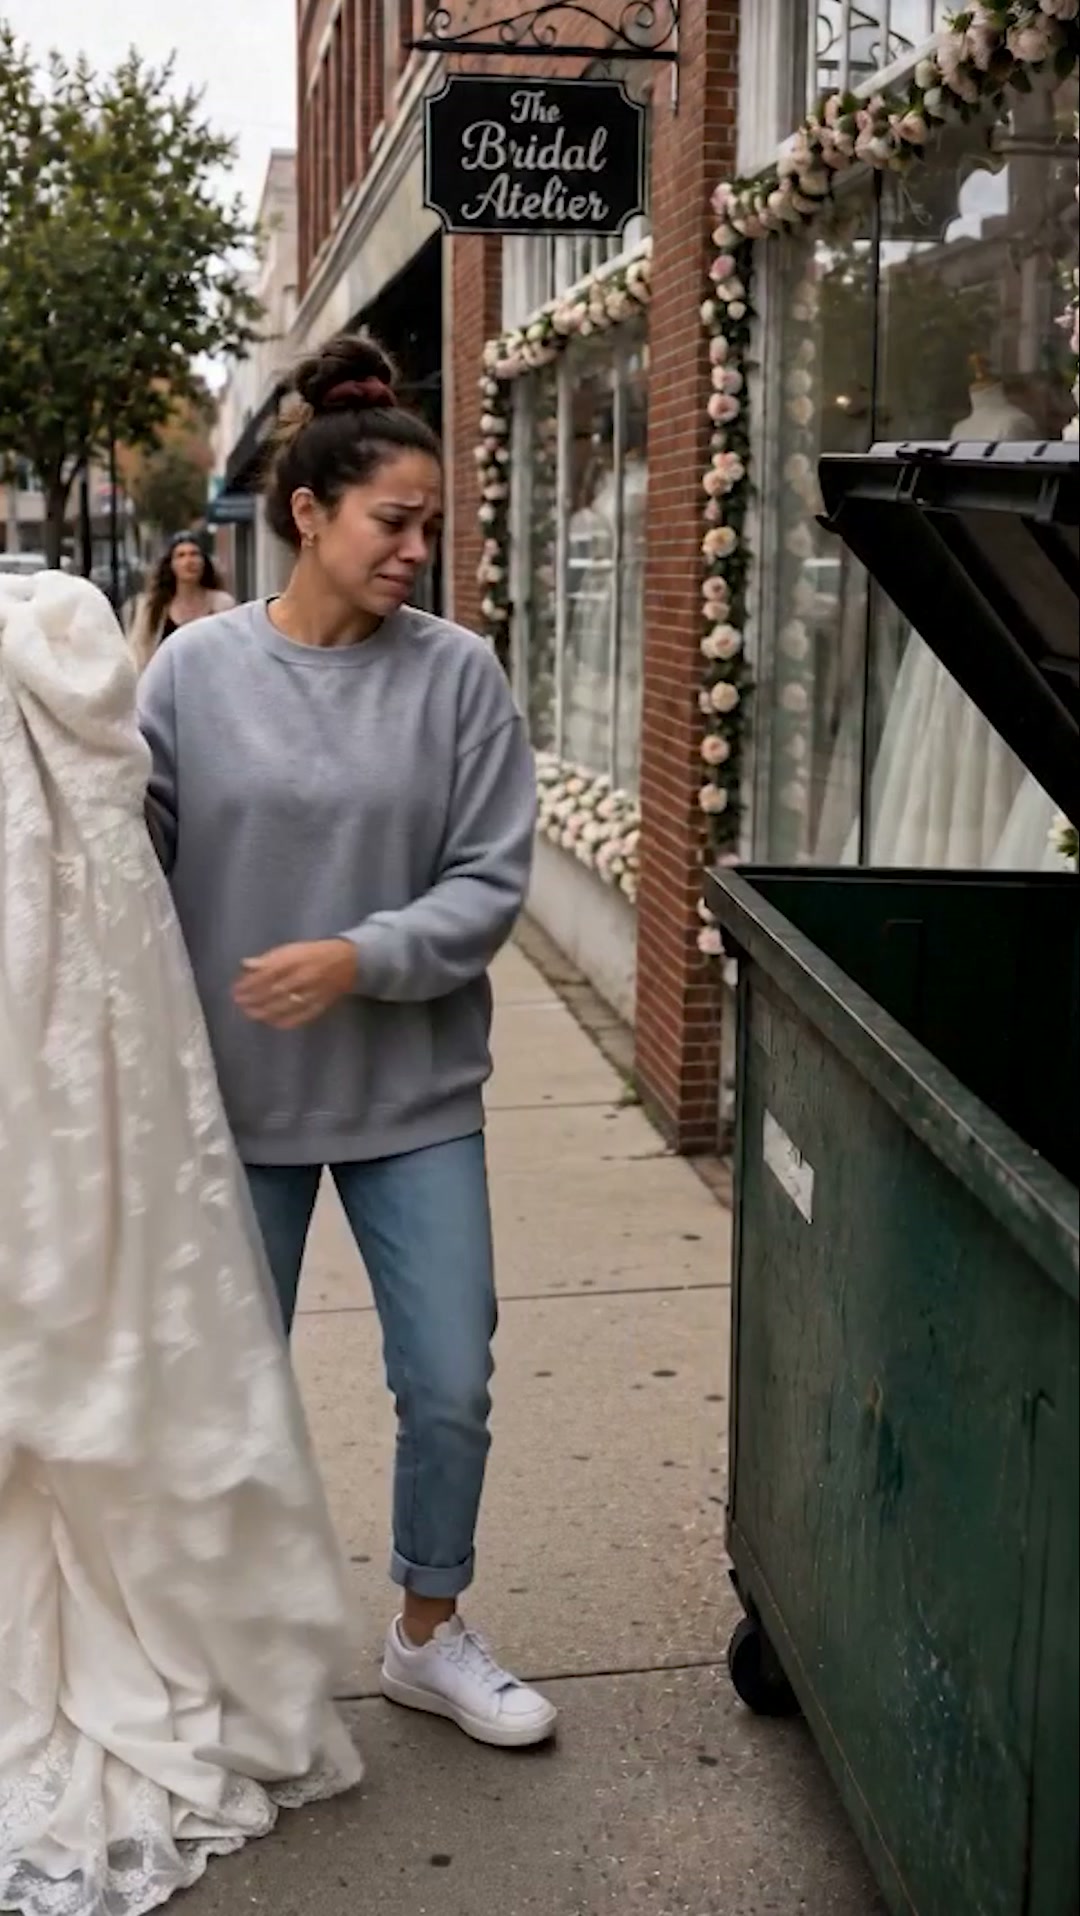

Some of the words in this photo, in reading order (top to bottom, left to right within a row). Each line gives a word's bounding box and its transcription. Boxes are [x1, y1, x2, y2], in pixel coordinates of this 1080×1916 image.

[510, 90, 562, 123] The
[461, 120, 608, 171] Bridal
[461, 173, 609, 221] Atelier
